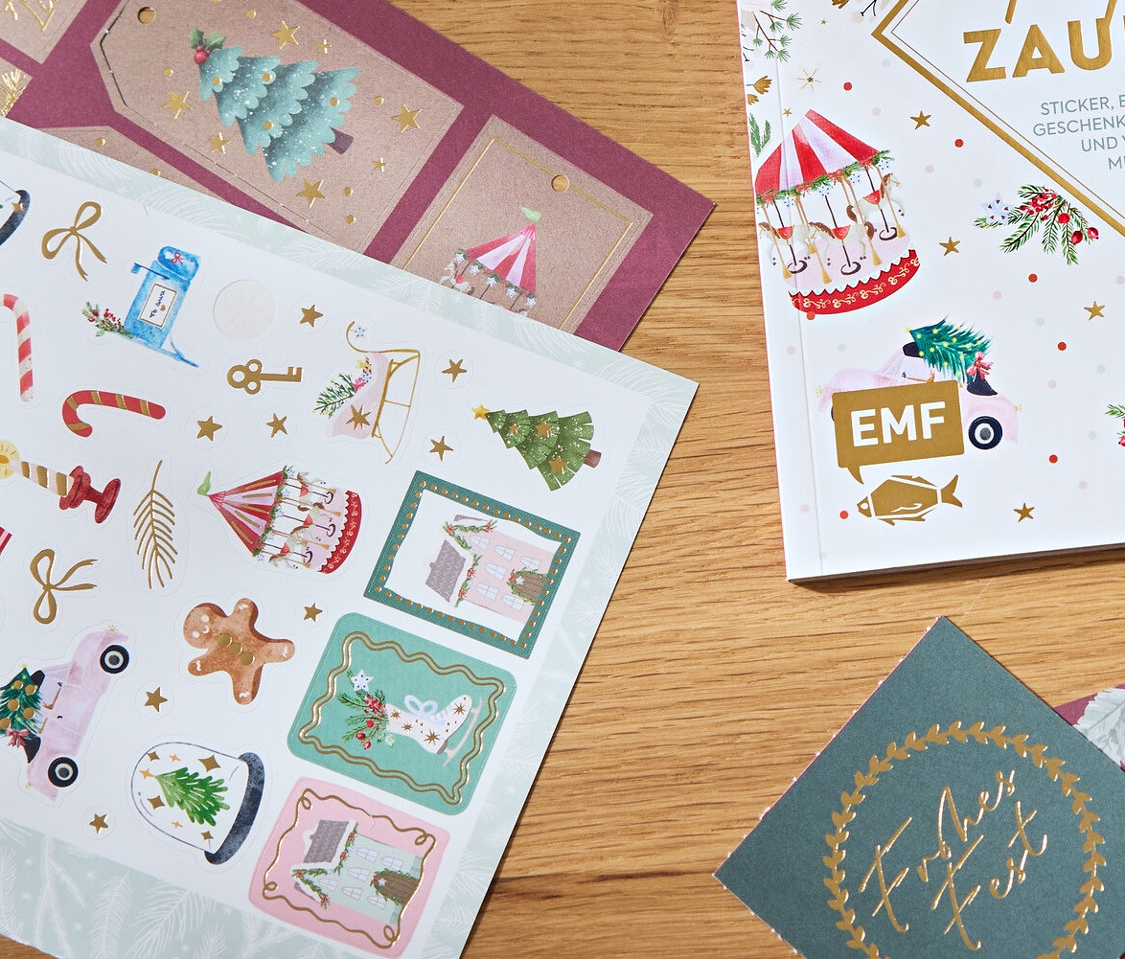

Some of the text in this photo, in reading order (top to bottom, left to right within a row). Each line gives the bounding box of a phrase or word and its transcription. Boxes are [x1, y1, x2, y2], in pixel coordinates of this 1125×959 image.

[1040, 96, 1114, 115] STICKER,
[1081, 136, 1118, 152] UND
[850, 401, 946, 447] EMF
[859, 770, 1015, 932] Frohes
[931, 800, 1048, 951] Fest
